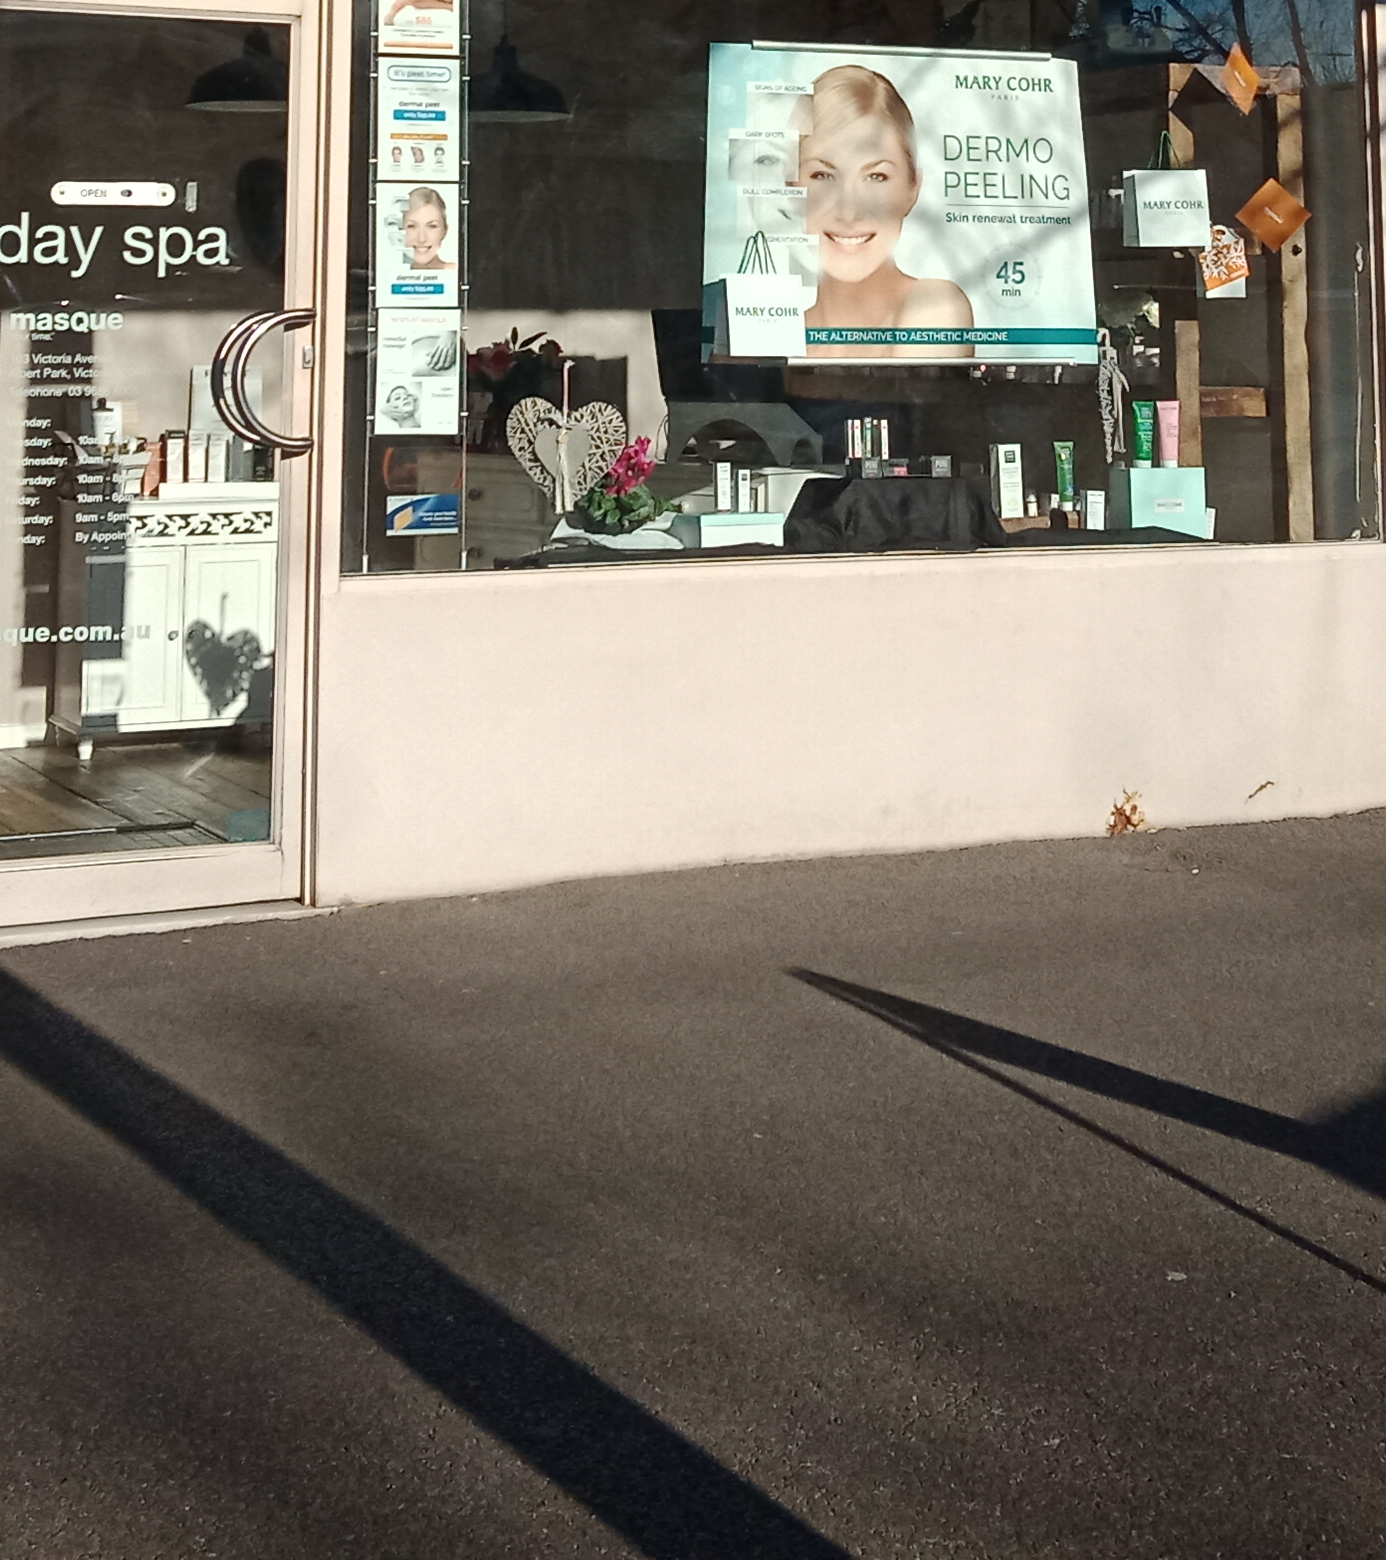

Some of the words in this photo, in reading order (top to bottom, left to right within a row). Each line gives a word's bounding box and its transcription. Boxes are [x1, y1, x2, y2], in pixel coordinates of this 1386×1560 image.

[955, 75, 1002, 92] MARY
[1007, 77, 1054, 93] COHR
[943, 135, 1053, 163] DERMO
[943, 171, 1071, 201] PEELING
[80, 189, 107, 198] OPEN
[1143, 200, 1172, 210] MARY
[1174, 200, 1204, 209] COHR
[945, 211, 969, 224] Skin
[972, 213, 1016, 224] renewal
[1019, 214, 1072, 226] treatment
[121, 224, 230, 278] spa
[995, 261, 1026, 285] 45
[1001, 287, 1022, 298] min
[735, 306, 765, 317] MARY
[768, 306, 799, 318] COHR
[808, 330, 828, 341] THE
[829, 330, 893, 341] ALTERNATIVE
[894, 331, 908, 341] TO
[910, 331, 962, 342] AESTHETIC
[963, 331, 1009, 342] MEDICINE
[31, 353, 72, 364] Victoria
[43, 367, 71, 380] Park,
[68, 386, 83, 397] 03
